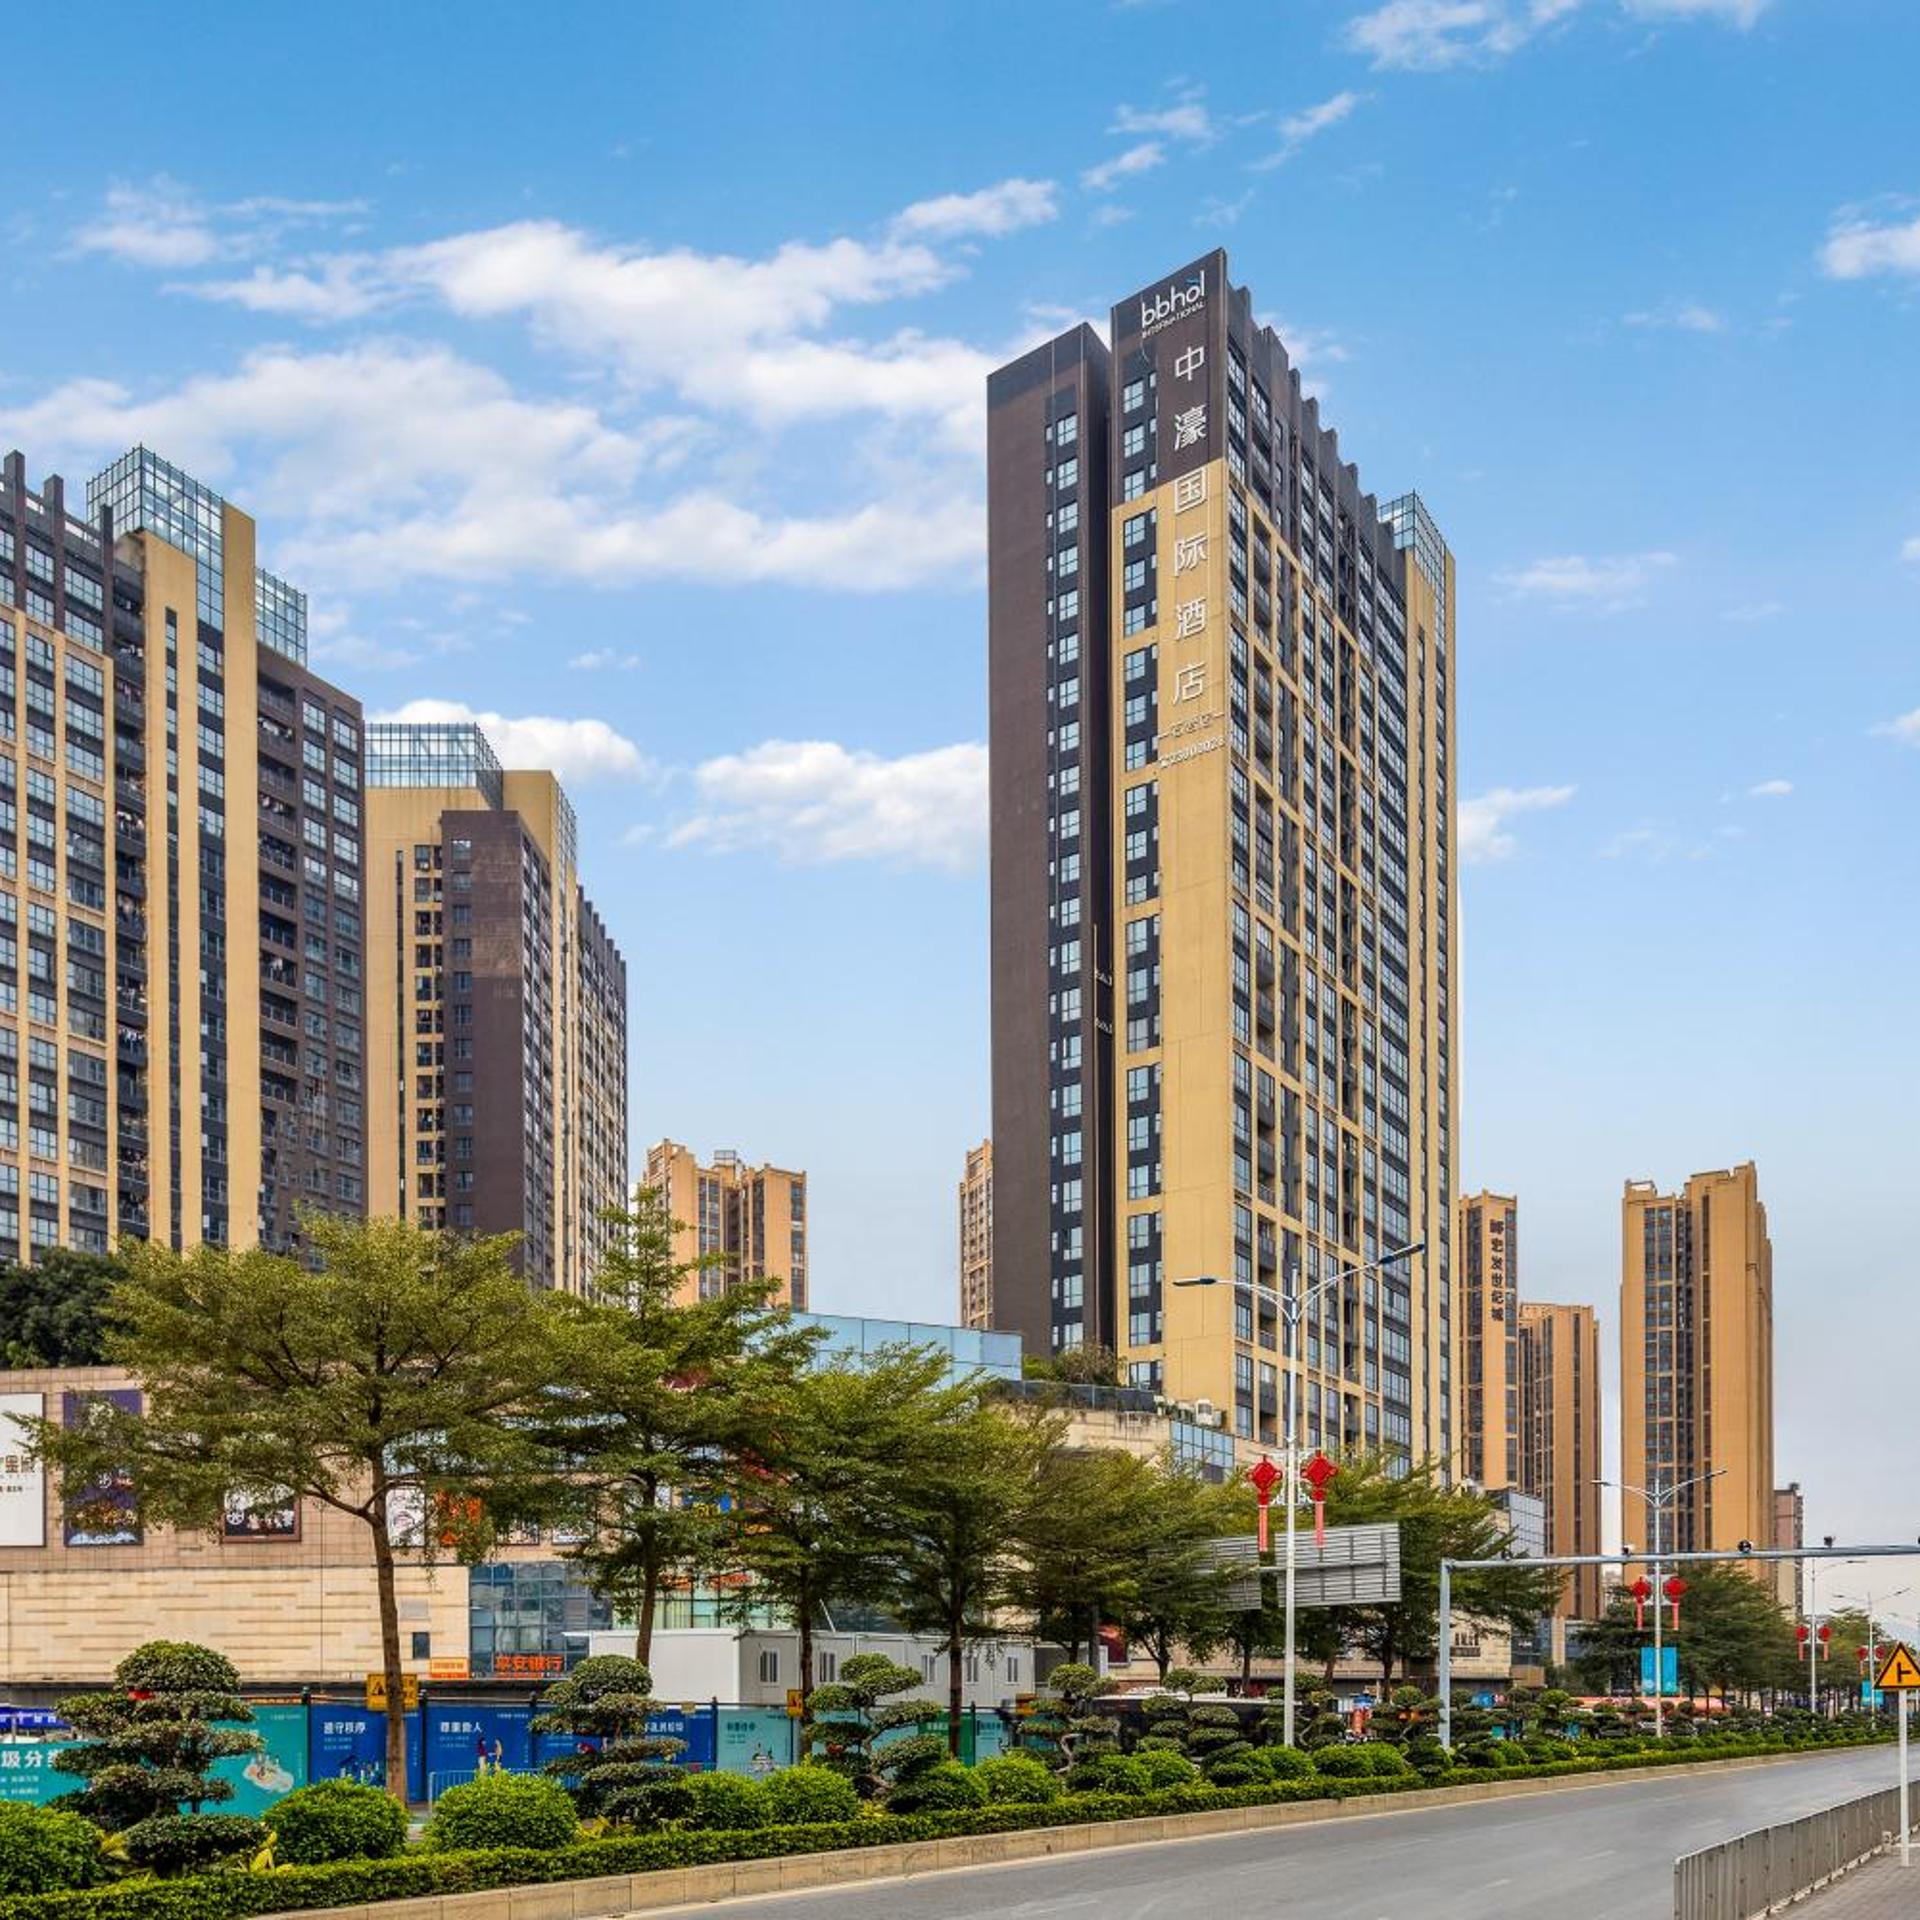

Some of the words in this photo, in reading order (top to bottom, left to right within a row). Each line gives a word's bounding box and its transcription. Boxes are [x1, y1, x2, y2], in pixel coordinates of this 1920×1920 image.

[1142, 270, 1204, 328] bbhol
[1173, 346, 1208, 704] 中濠国际酒店
